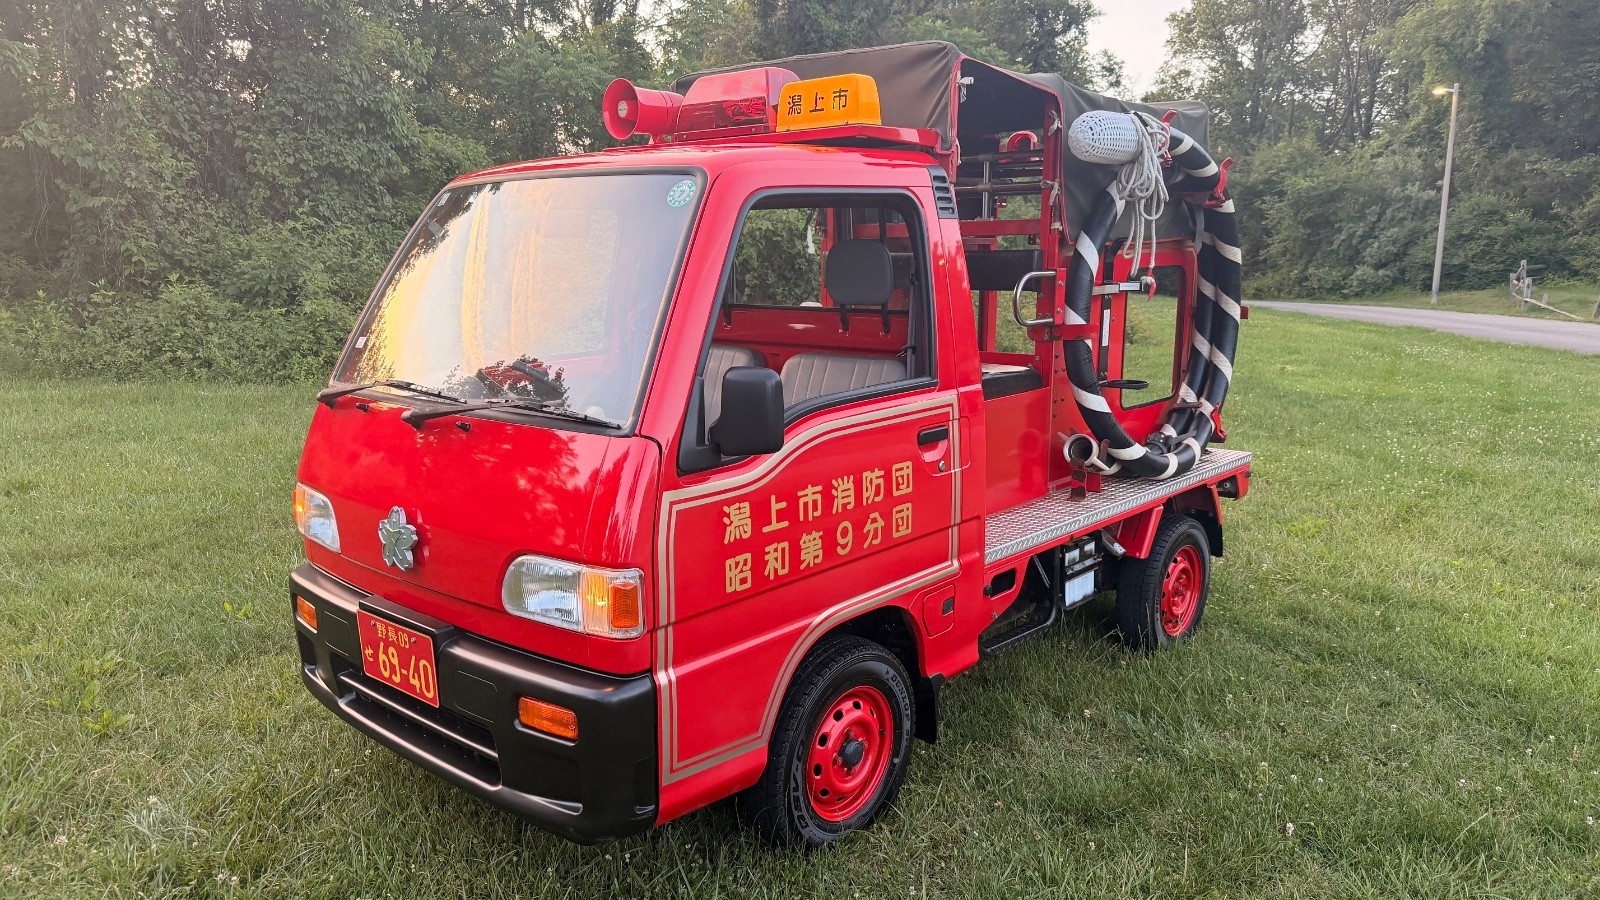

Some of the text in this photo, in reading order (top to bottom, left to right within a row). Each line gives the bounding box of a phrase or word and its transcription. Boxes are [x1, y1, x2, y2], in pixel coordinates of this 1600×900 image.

[787, 88, 849, 116] 潟上市
[722, 461, 913, 544] 潟上市消防団
[725, 503, 913, 593] 昭和第9分団
[364, 642, 434, 698] せ 69-40
[889, 673, 911, 722] DUNLOP
